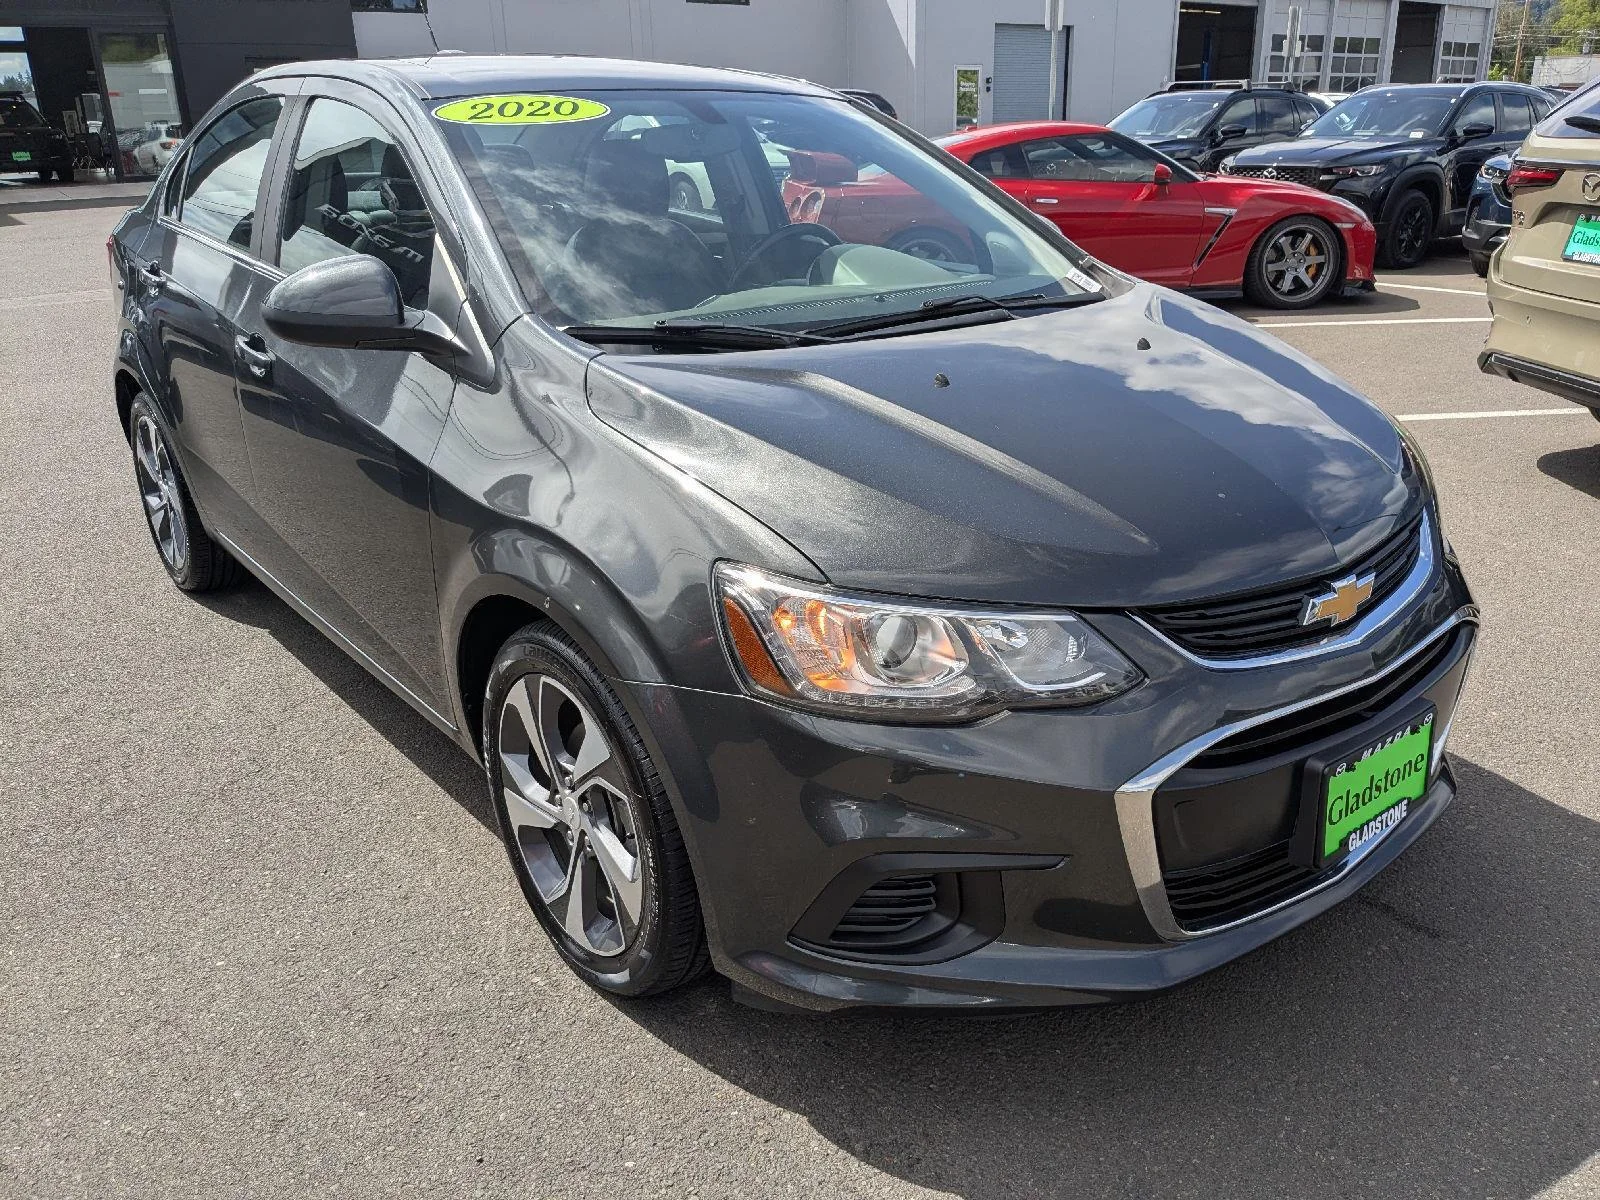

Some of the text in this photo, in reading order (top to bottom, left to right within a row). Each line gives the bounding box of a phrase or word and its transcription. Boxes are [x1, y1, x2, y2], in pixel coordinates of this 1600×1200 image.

[467, 100, 580, 121] 2020
[1573, 231, 1600, 247] Glads
[1361, 725, 1411, 761] MAZDA
[1328, 753, 1425, 826] Gladstone
[1348, 799, 1408, 851] GLADSTONE
